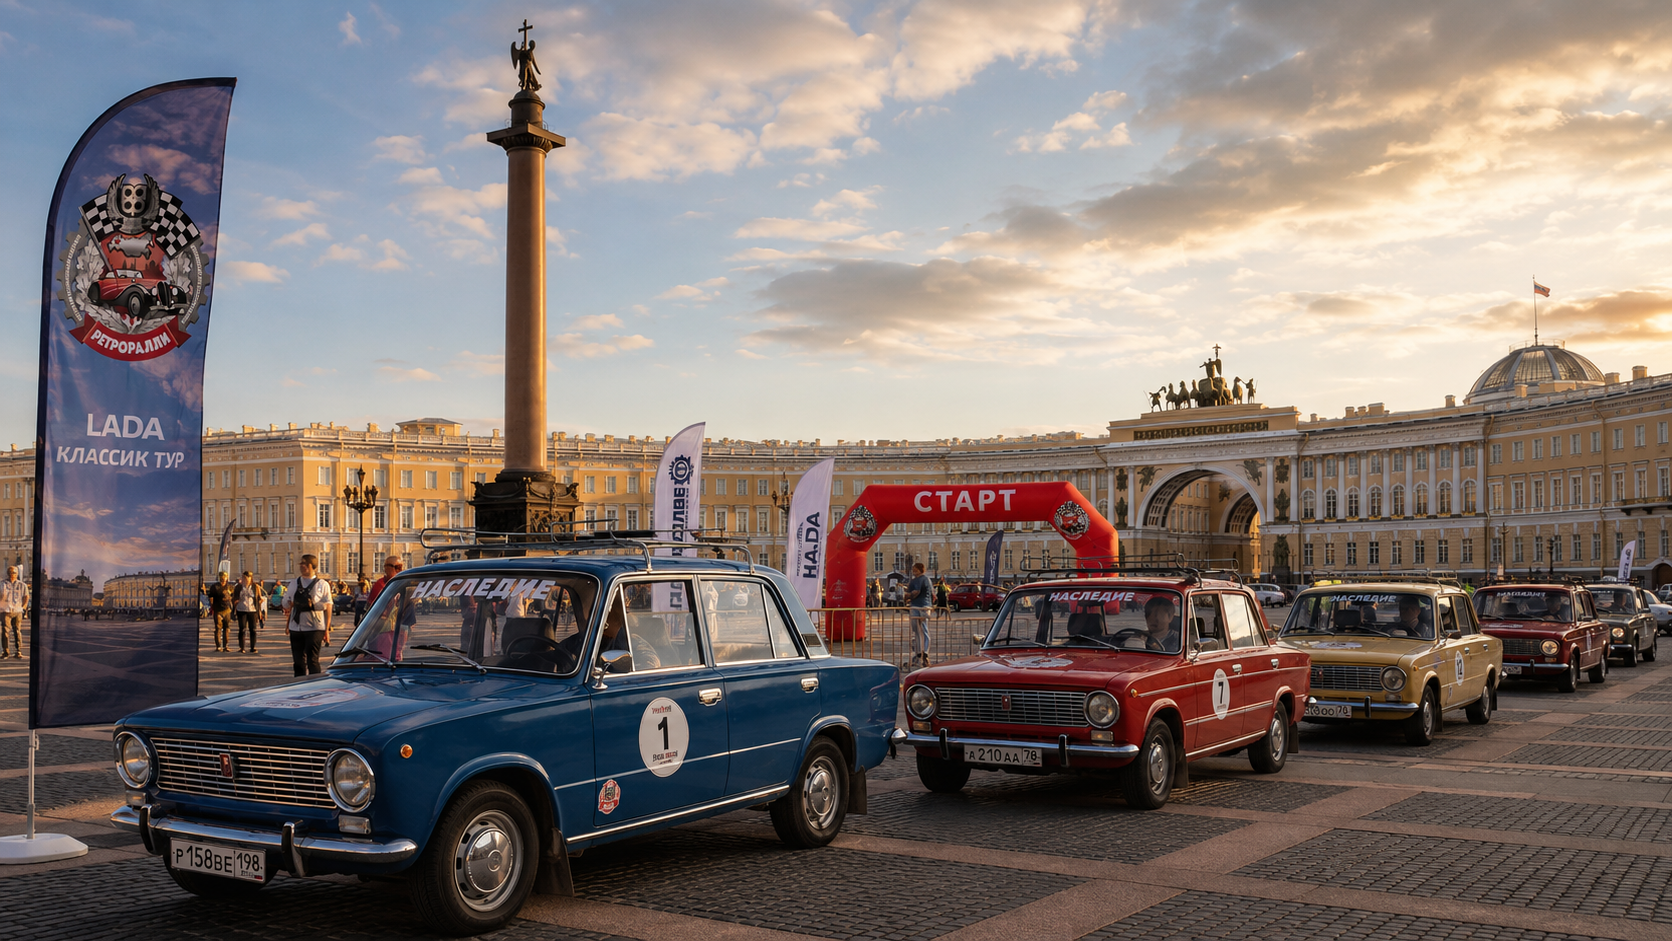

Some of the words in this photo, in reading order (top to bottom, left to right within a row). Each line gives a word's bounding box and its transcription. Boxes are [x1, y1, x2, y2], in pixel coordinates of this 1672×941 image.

[90, 329, 171, 355] РЕТРОРАЛЛИ
[87, 413, 165, 440] LADA
[56, 446, 148, 468] КЛАССИК
[154, 452, 185, 468] ТУР
[914, 488, 1017, 512] СТАРТ
[410, 578, 556, 600] НАСЛЕДИЕ
[1048, 591, 1135, 603] НАСЛЕДИЕ
[1218, 681, 1224, 704] 7
[658, 716, 669, 750] 1
[236, 852, 260, 872] 198
